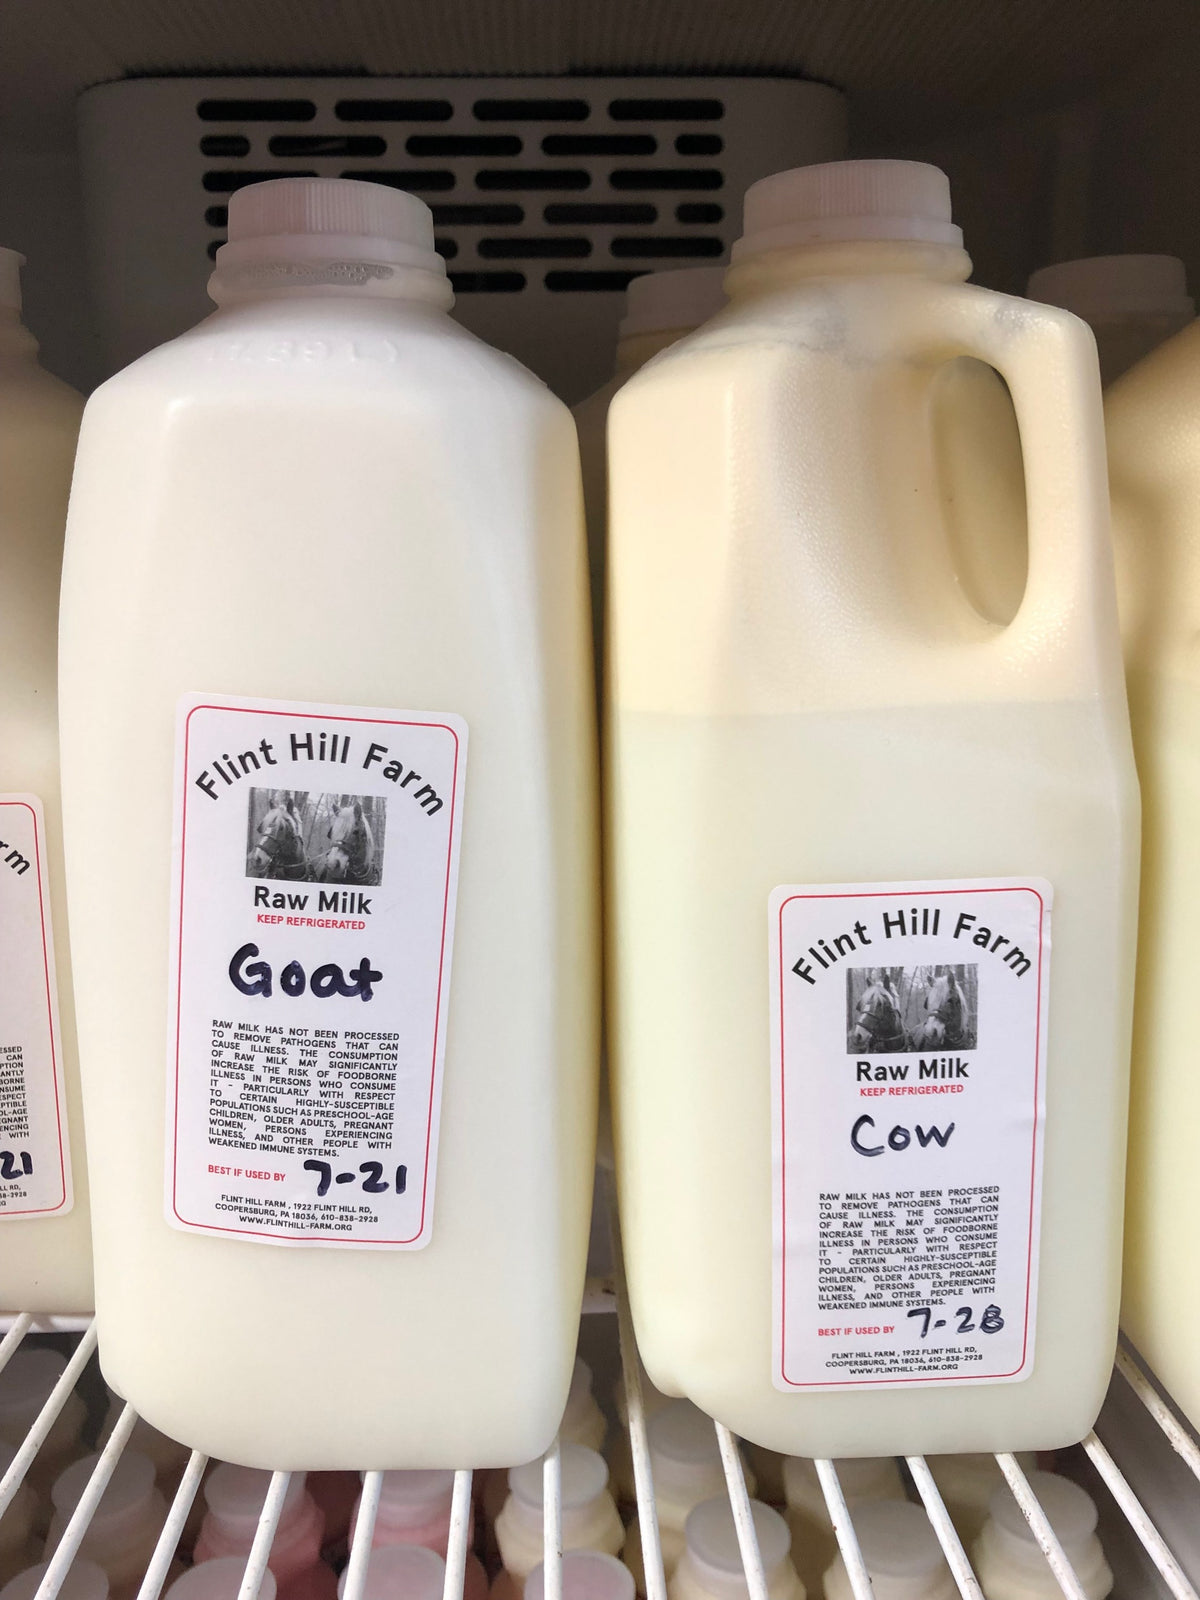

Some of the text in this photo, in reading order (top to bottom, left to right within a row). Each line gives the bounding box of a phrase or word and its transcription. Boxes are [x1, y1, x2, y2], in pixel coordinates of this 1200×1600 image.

[195, 732, 444, 817] Flint Hill Farm
[254, 885, 373, 915] Raw Milk
[257, 914, 365, 930] KEEP REFRIGERATED
[791, 908, 1032, 985] Flint Hill Farm
[229, 943, 383, 1002] Goat
[212, 1019, 399, 1041] RAW MILK HAS NOT BEEN PROCESSED
[211, 1039, 398, 1061] CAUSE ILLNESS. THE CONSUMPTION
[233, 1032, 398, 1051] REMOVE PATHOGENS THAT CAN
[211, 1059, 397, 1081] INCREASE THE RISK FOODBORNE
[234, 1052, 398, 1071] RAW MILK MAY SIGNIFICANTLY
[856, 1057, 970, 1082] Raw Milk
[211, 1069, 396, 1091] ILLNESS PERSONS WHO CONSUME
[243, 1083, 396, 1100] PARTICULARLY WITH RESPECT
[860, 1084, 964, 1097] KEEP REFRIGERATED
[210, 1098, 394, 1120] POPULATIONS SUCH PRESCHOOL-AGE
[239, 1092, 395, 1110] CERTAIN HIGHLY-SUSCEPTIBLE
[209, 1108, 394, 1130] CHILDREN, OLDER ADULTS, PREGNANT
[9, 1131, 30, 1139] WITH
[209, 1117, 392, 1140] WOMEN, PERSONS EXPERIENCING
[850, 1114, 955, 1157] Cow
[208, 1136, 339, 1157] WEAKENED IMMUNE SYSTEMS.
[209, 1127, 392, 1149] ILLNESS, AND OTHER PEOPLE WITH
[0, 1151, 33, 1180] 21
[208, 1164, 286, 1182] BEST IF USED BY
[303, 1159, 408, 1197] 7-21
[819, 1193, 840, 1201] RAW
[872, 1192, 890, 1200] HAS
[895, 1191, 915, 1199] NOT
[919, 1190, 942, 1198] BEEN
[948, 1185, 1000, 1196] PROCESSED
[221, 1194, 372, 1214] FLINT HILL FARM 1922 FLINT HILL RD,
[841, 1195, 999, 1210] REMOVE PATHOGENS THAT CAN
[907, 1209, 924, 1217] THE
[933, 1204, 999, 1216] CONSUMPTION
[215, 1203, 378, 1223] COOPERSBURG, PA 18036, 610-838-2928
[874, 1220, 895, 1228] MILK
[905, 1218, 924, 1226] MAY
[934, 1214, 998, 1225] SIGNIFICANTLY
[239, 1215, 352, 1231] WWW.FLINTHILL-FARM.ORG
[819, 1222, 998, 1238] INCREASE THE RISK FOODBORNE
[819, 1232, 997, 1248] ILLNESS PERSONS WHO CONSUME
[852, 1241, 998, 1256] PARTICULARLY WITH RESPECT
[819, 1259, 996, 1274] POPULATIONS SUCH PRESCHOOL-AGE
[848, 1250, 997, 1265] CERTAIN HIGHLY-SUSCEPTIBLE
[872, 1274, 902, 1282] OLDER
[949, 1268, 995, 1278] PREGNANT
[874, 1282, 915, 1291] PERSONS
[932, 1277, 995, 1288] EXPERIENCING
[864, 1292, 883, 1300] AND
[891, 1290, 921, 1299] OTHER
[930, 1288, 963, 1297] PEOPLE
[972, 1286, 995, 1294] WITH
[818, 1302, 867, 1310] WEAKENED
[869, 1300, 903, 1308] IMMUNE
[907, 1304, 1005, 1338] 7-28
[818, 1325, 895, 1336] BEST IF USED BY
[928, 1354, 983, 1363] 610-838-2928
[849, 1363, 958, 1374] WWW.FLINTHILL-FARM.ORG
